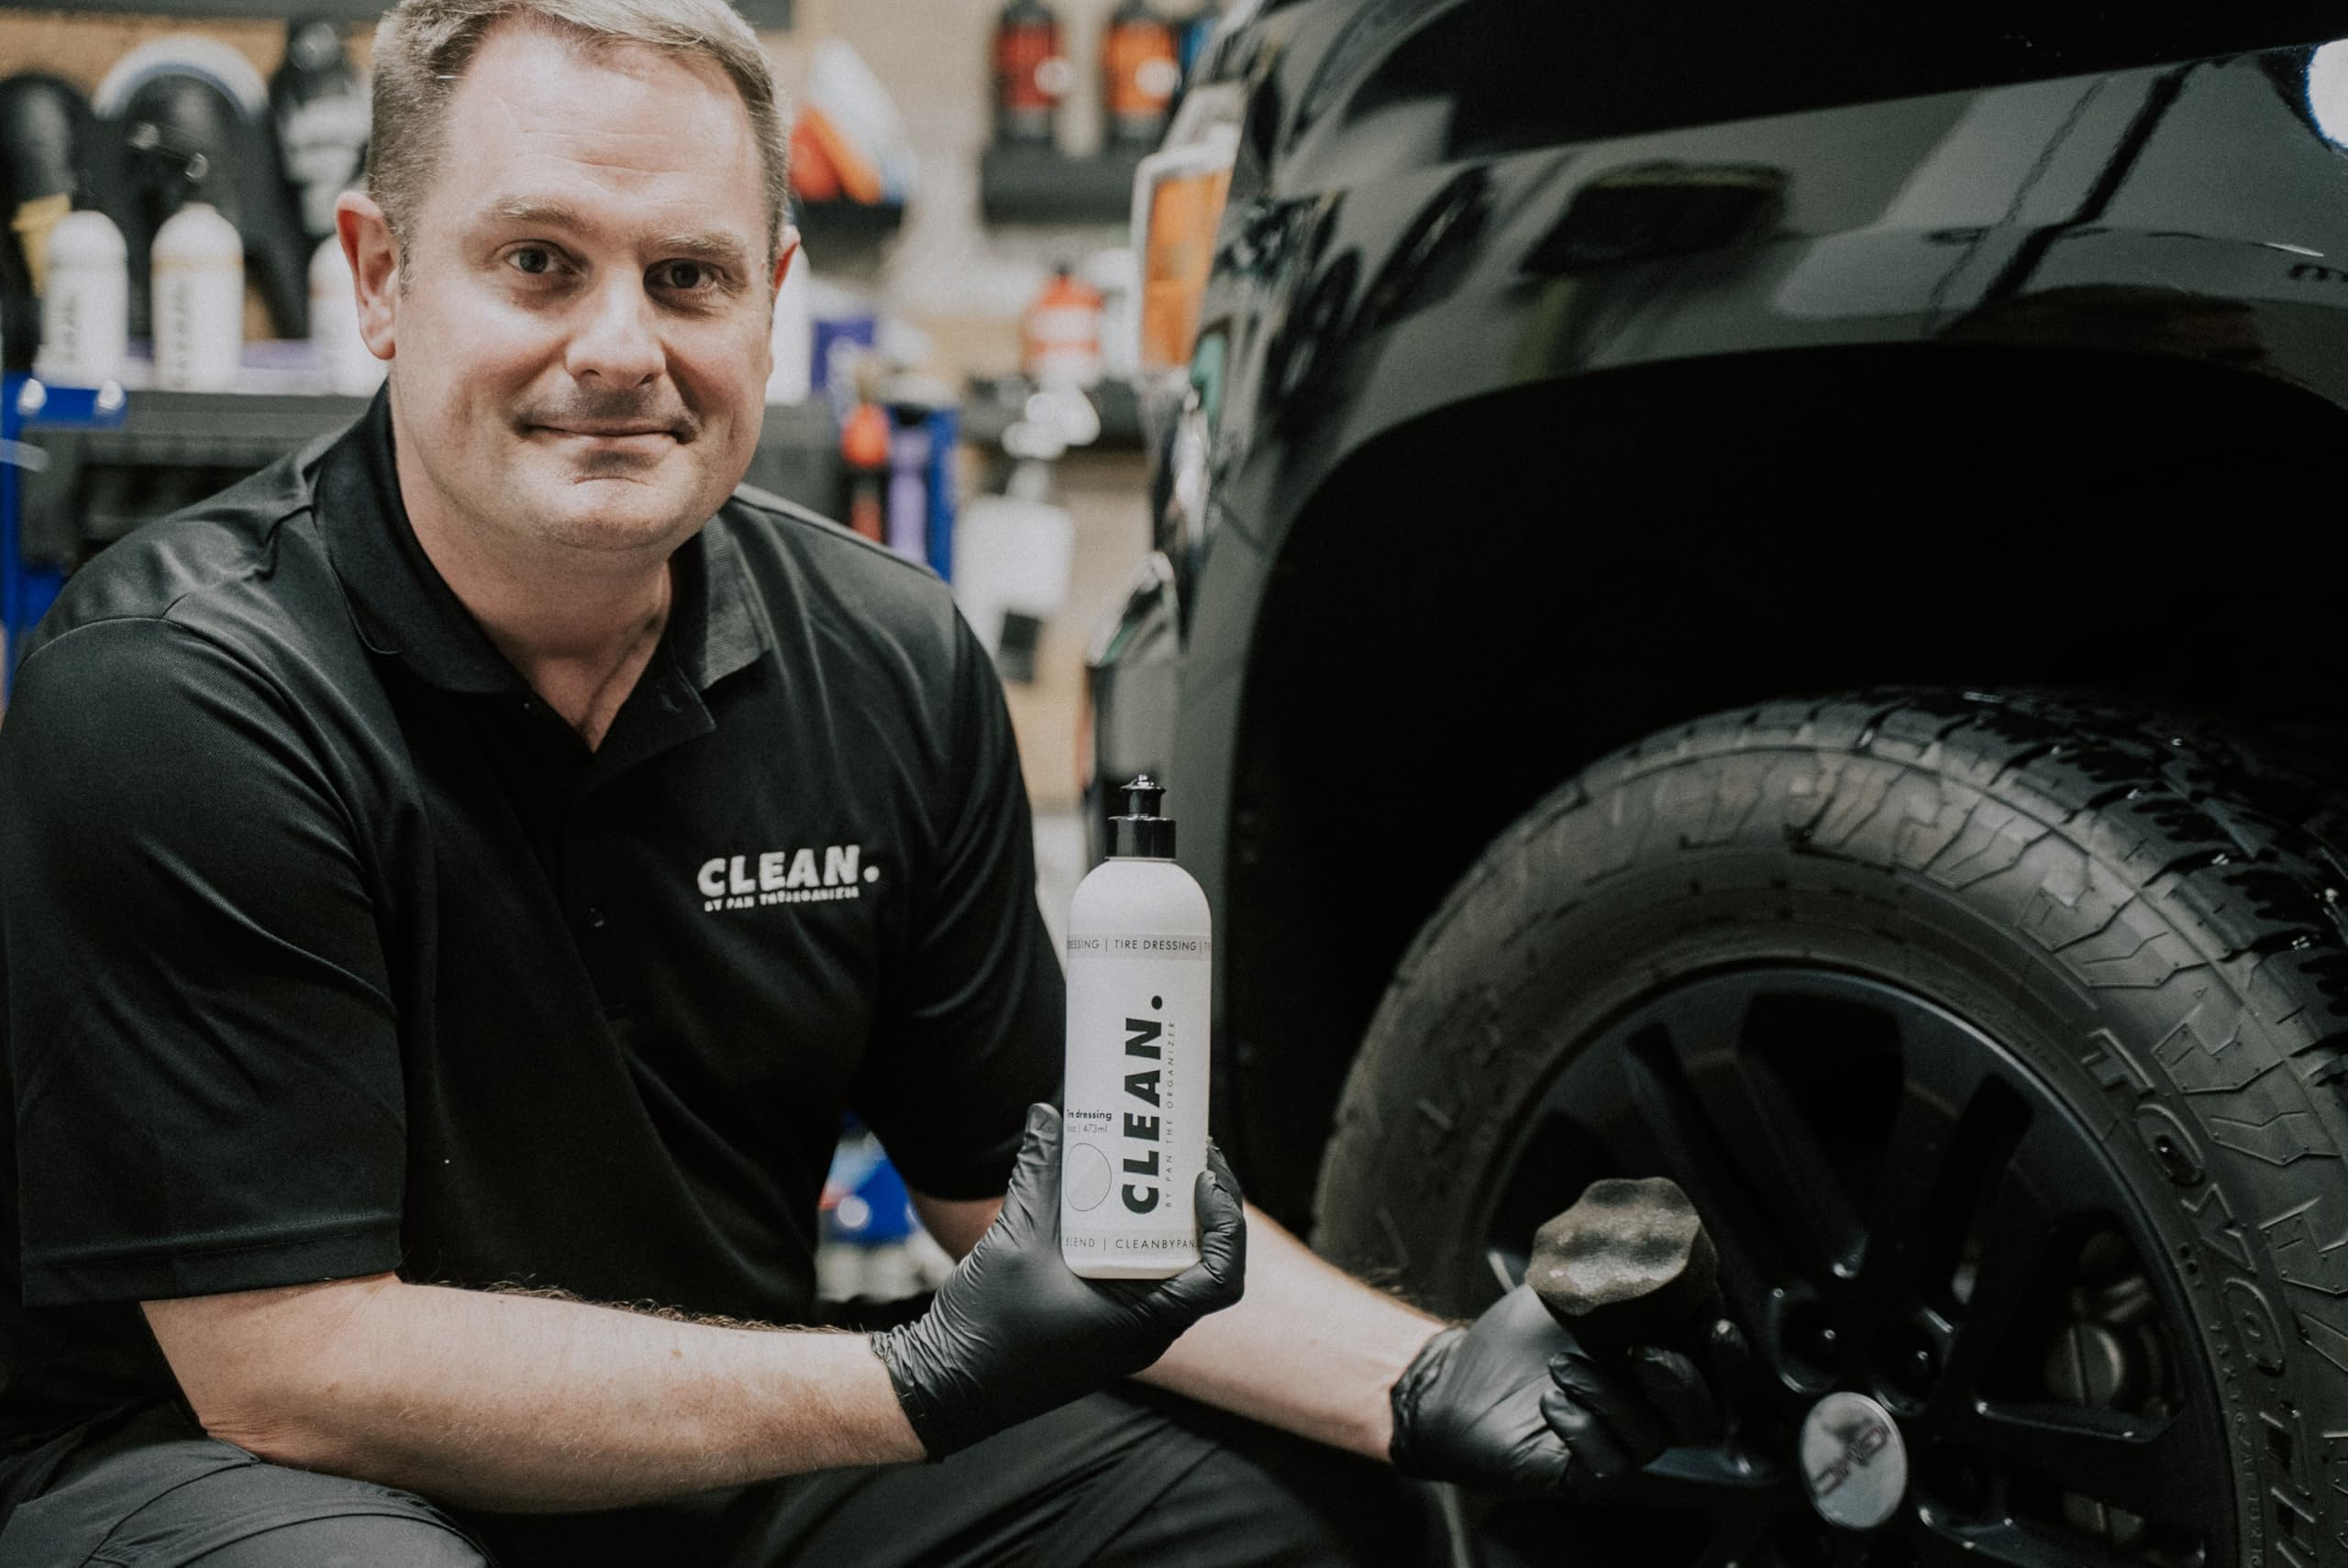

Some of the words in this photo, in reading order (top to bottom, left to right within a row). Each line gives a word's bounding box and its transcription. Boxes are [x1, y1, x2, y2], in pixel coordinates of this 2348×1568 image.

[697, 845, 880, 897] CLEAN.
[704, 899, 722, 911] BY
[725, 895, 755, 909] PAN
[1114, 939, 1138, 950] TIRE
[1143, 940, 1197, 951] DRESSING
[1166, 1022, 1175, 1109] ORGANIZER
[1122, 995, 1163, 1214] CLEAN.
[1076, 1109, 1112, 1121] dressing
[1165, 1193, 1172, 1208] BY
